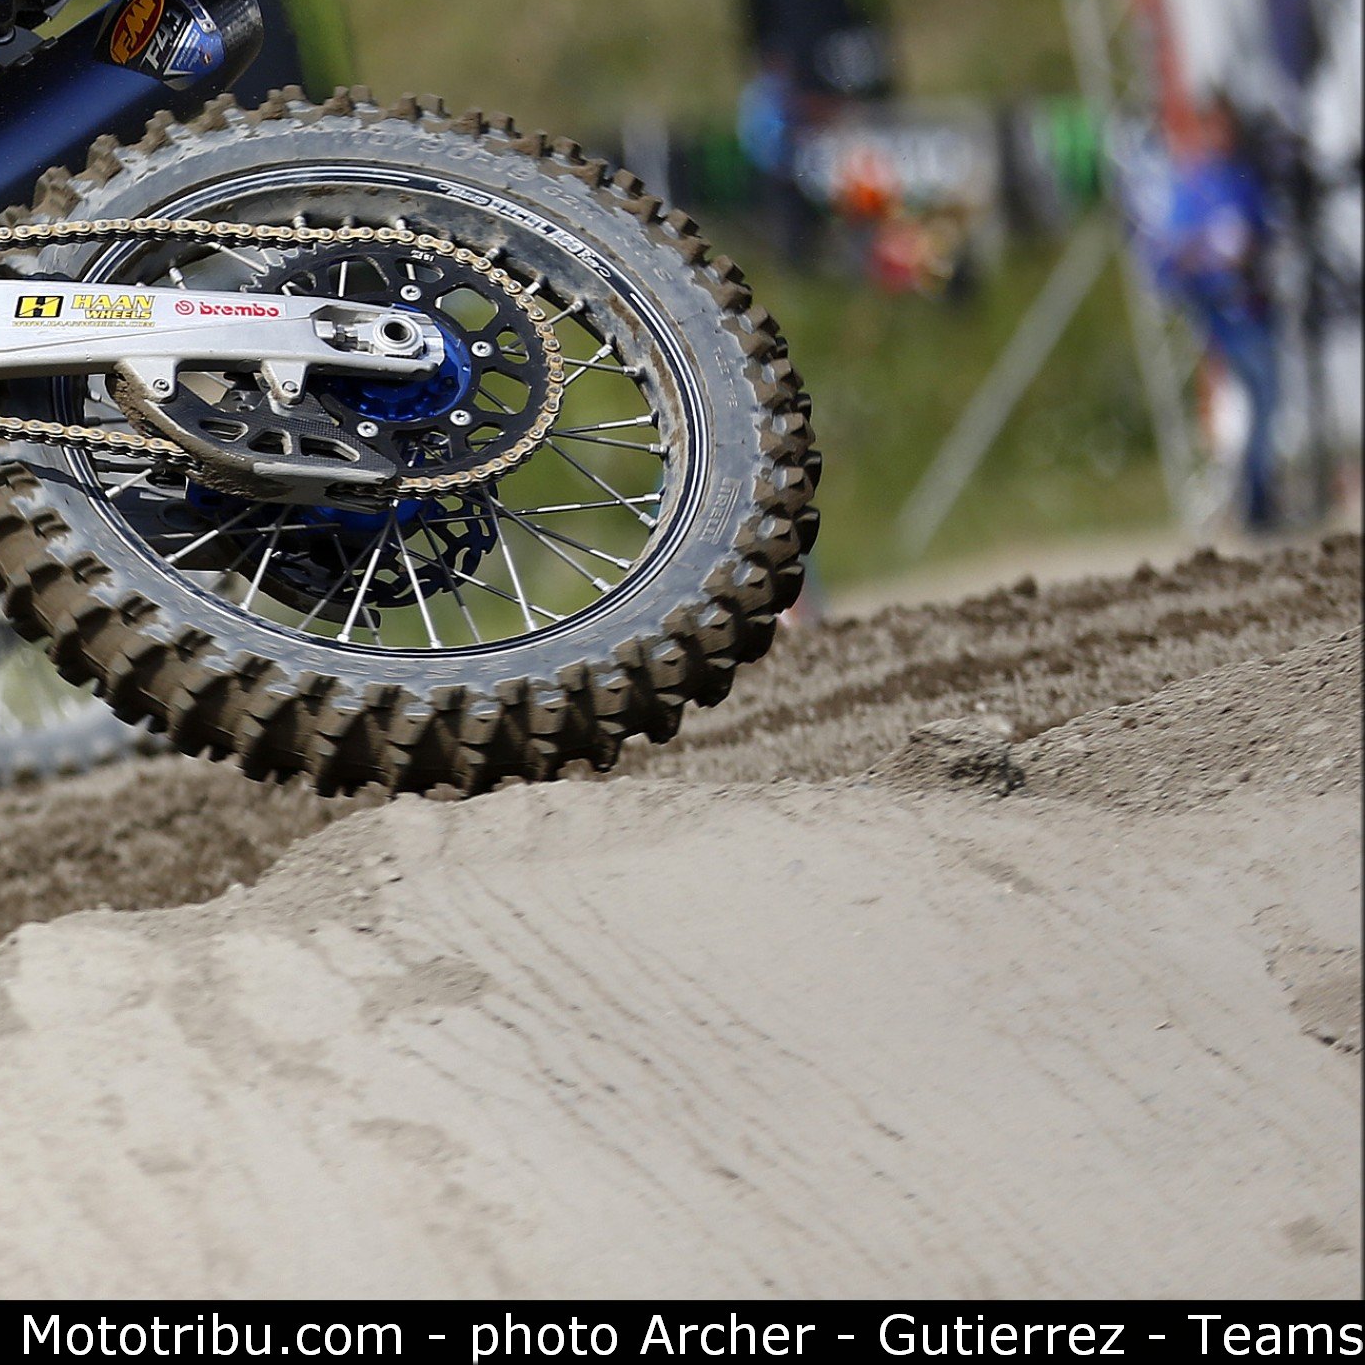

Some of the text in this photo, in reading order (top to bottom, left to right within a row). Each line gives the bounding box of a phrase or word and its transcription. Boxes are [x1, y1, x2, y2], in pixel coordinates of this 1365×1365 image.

[72, 295, 155, 310] HAAN
[200, 301, 280, 318] brembo
[85, 310, 152, 320] WHEELS
